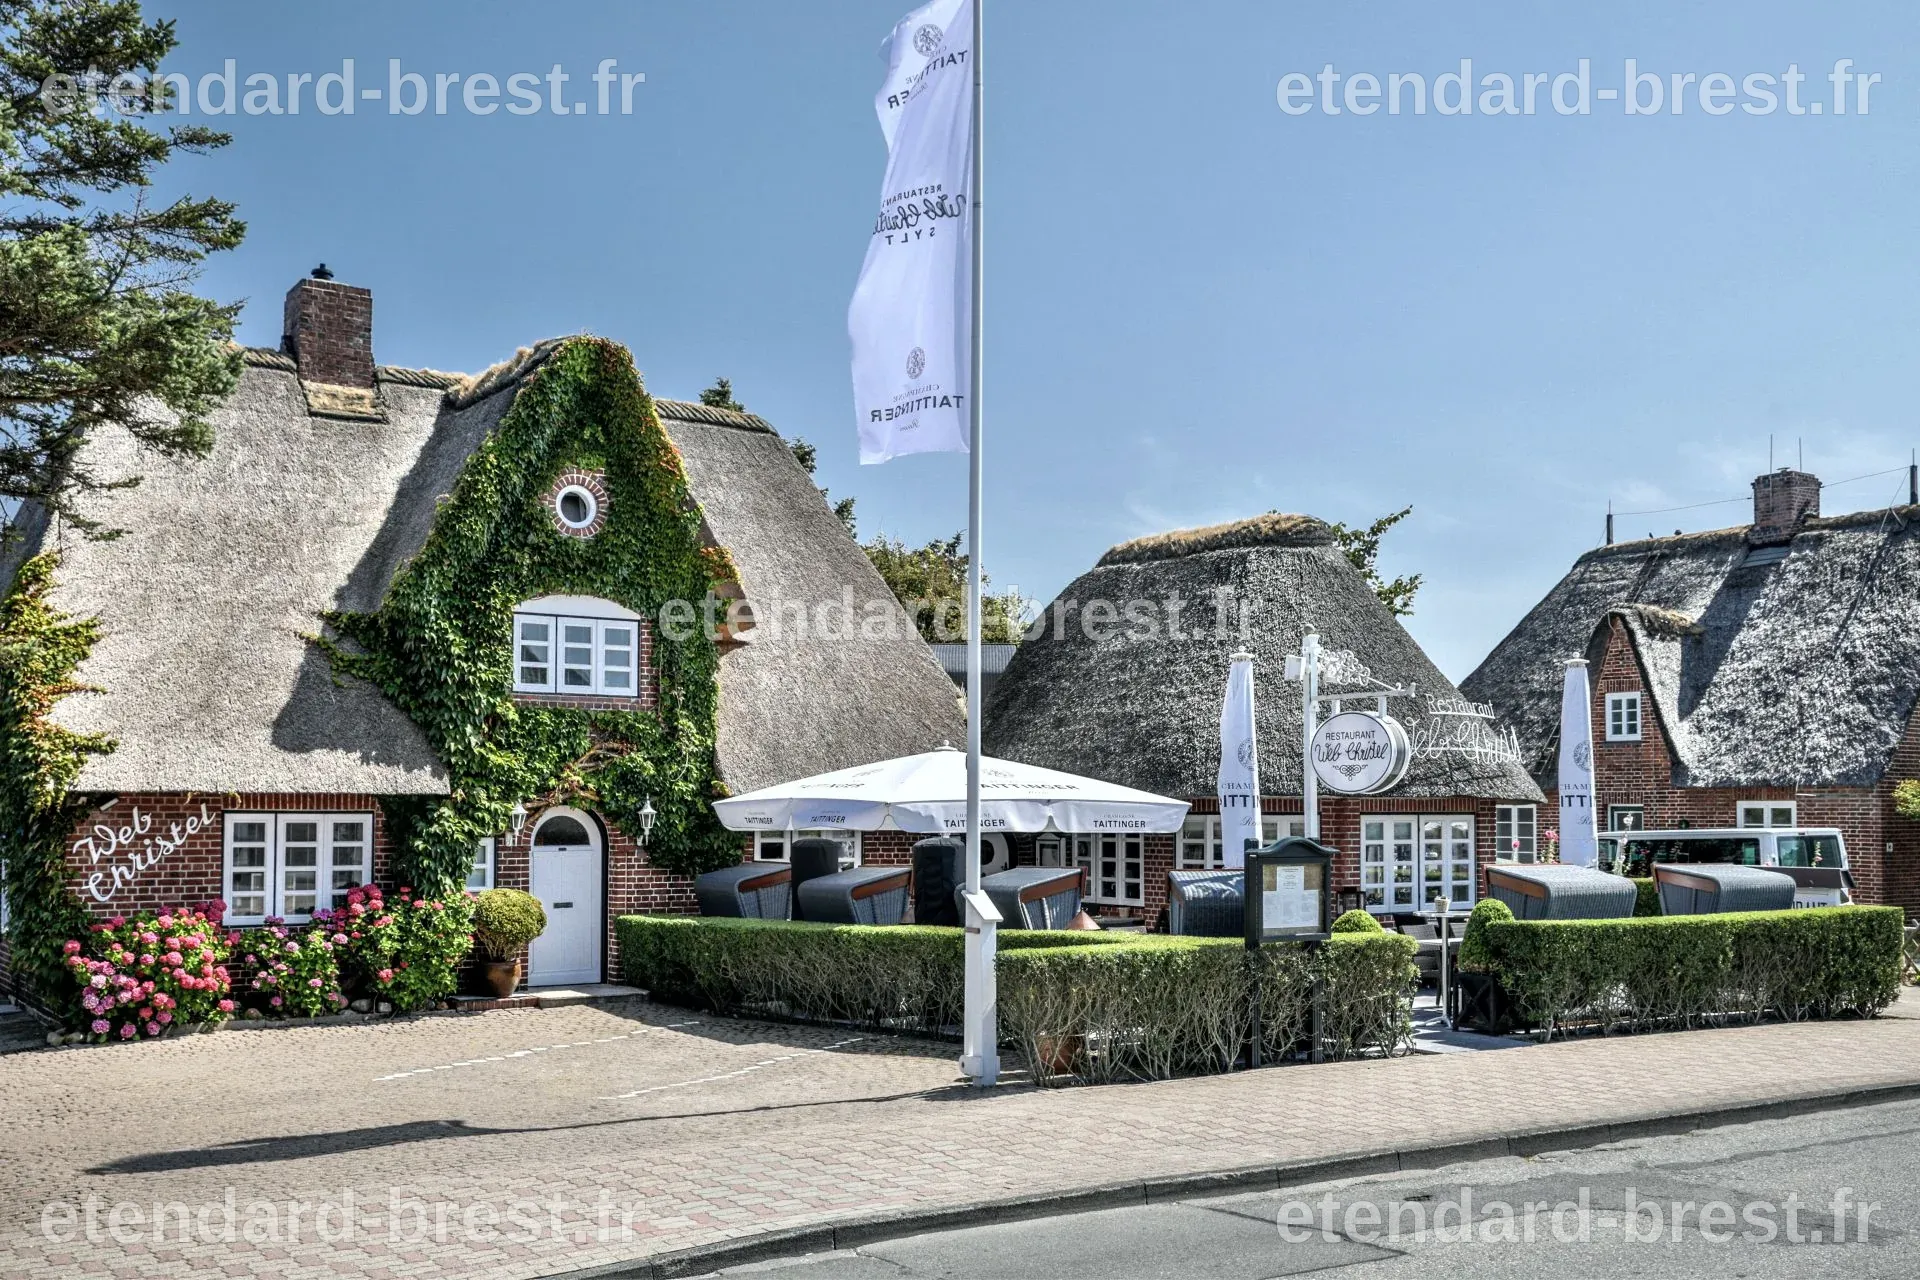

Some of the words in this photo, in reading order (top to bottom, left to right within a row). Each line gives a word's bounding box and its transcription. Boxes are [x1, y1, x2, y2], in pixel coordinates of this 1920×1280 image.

[1425, 693, 1496, 719] Restaurant
[1325, 730, 1376, 741] RESTAURANT
[1345, 740, 1389, 761] Christel
[744, 816, 774, 825] TAITTINGER
[809, 815, 846, 824] TAITTINGER
[943, 819, 1006, 828] TAITNGER
[1092, 820, 1146, 828] TAITTINGER
[72, 806, 153, 865] Web
